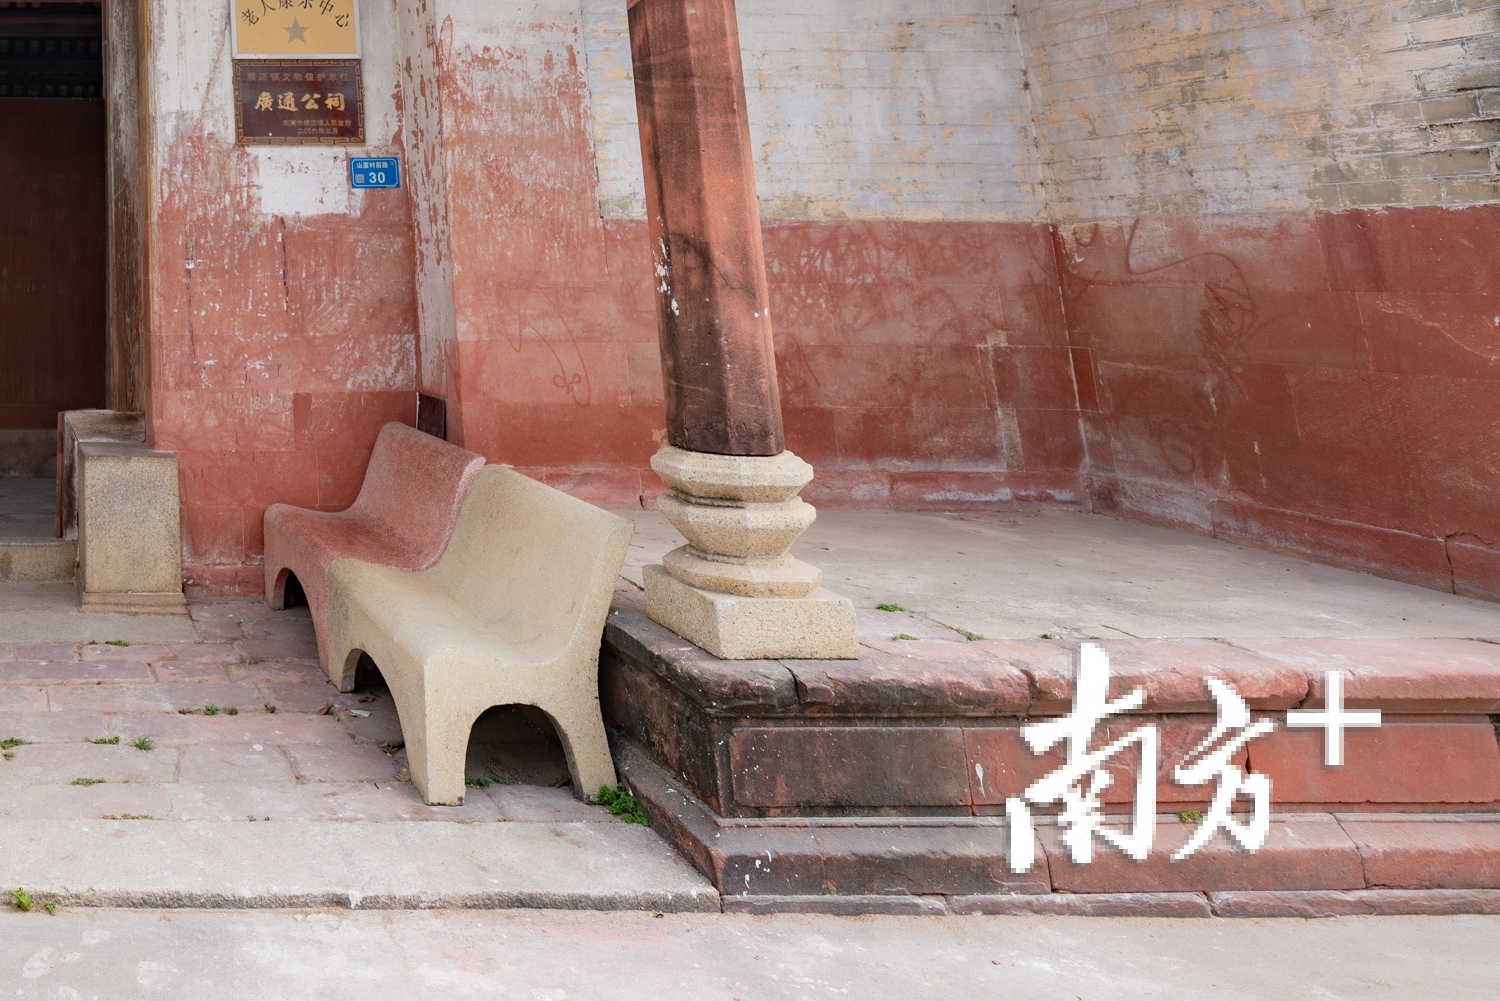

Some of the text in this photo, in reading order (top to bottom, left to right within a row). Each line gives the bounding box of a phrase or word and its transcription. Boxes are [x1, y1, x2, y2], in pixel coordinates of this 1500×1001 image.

[246, 72, 349, 82] 横沥镇文物保护单位
[255, 91, 345, 112] 廣通公祠
[282, 119, 352, 127] 东莞市横沥镇人民政府
[368, 171, 386, 184] 30
